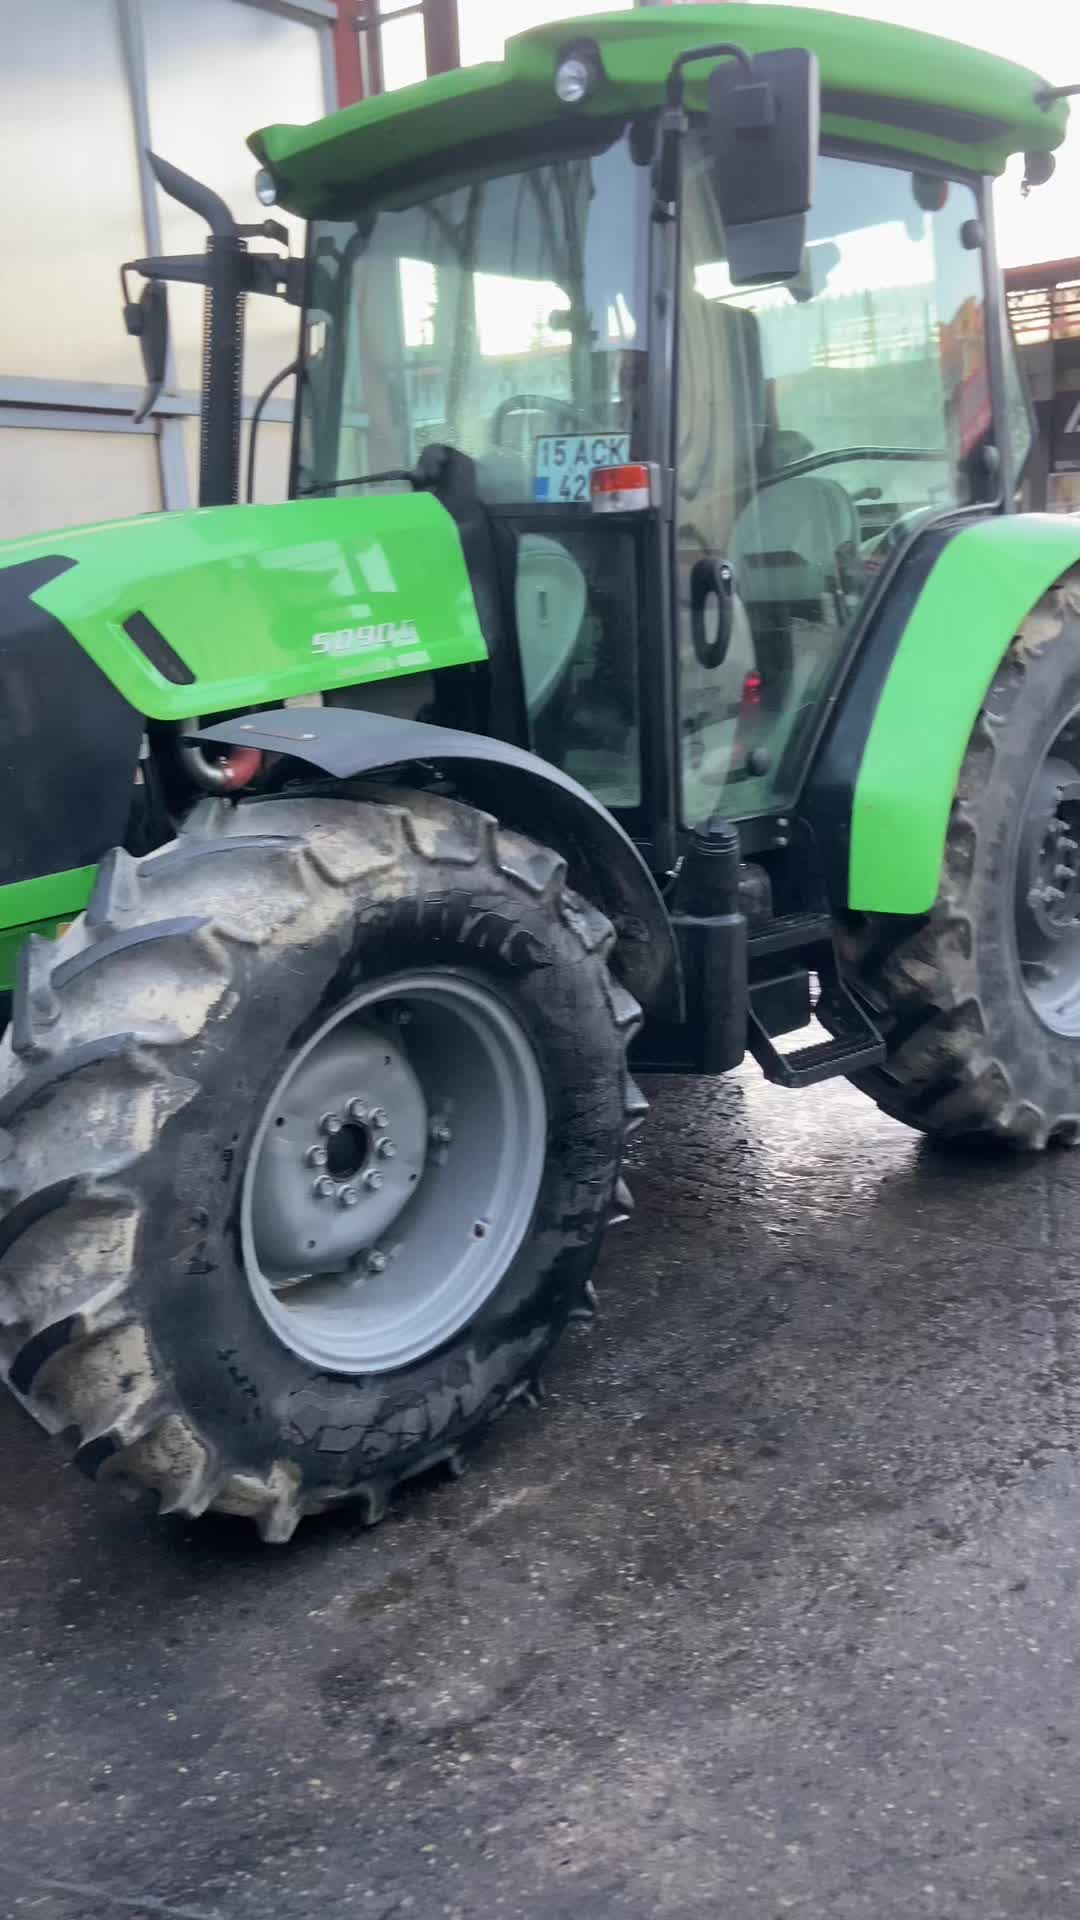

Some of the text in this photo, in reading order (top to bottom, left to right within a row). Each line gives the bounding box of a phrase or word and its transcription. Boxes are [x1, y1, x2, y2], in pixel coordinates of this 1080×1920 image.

[542, 437, 626, 467] 15 ACK
[558, 473, 588, 501] 42
